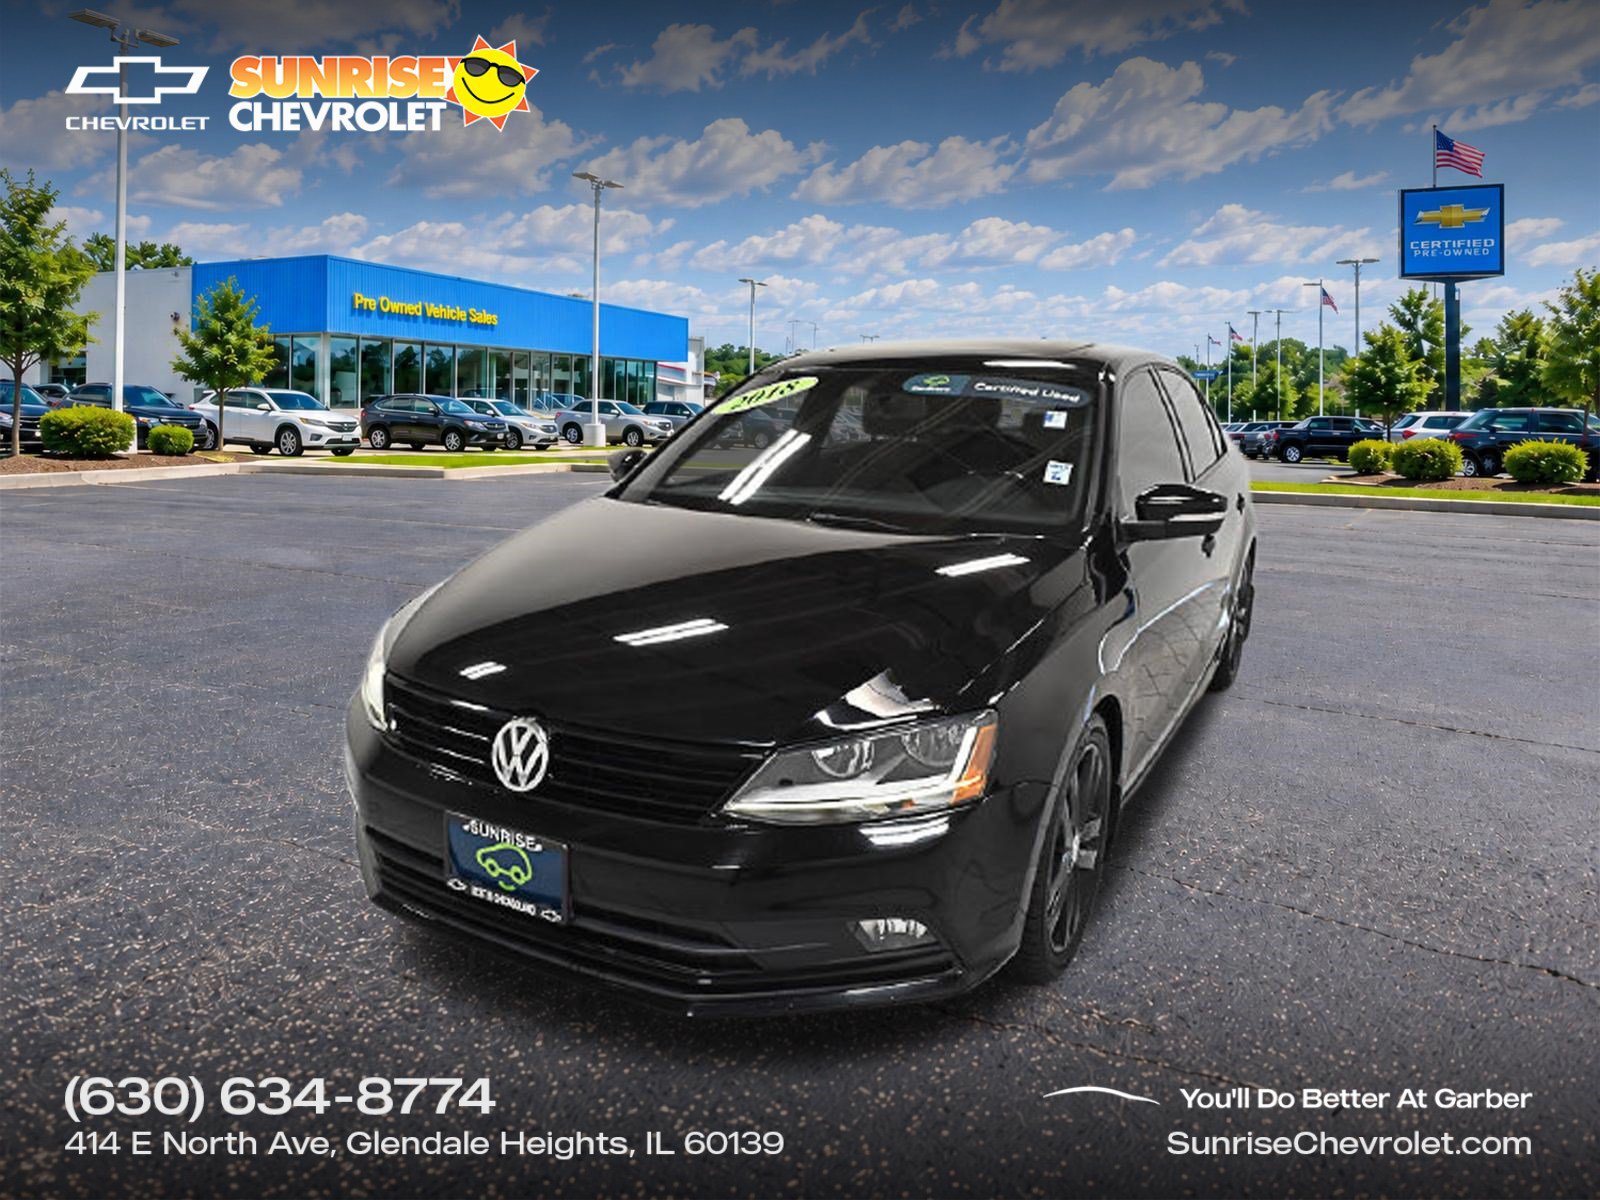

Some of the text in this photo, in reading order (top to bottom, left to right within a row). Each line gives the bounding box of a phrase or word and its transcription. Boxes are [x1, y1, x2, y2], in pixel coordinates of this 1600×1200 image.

[1410, 239, 1495, 249] CERTIFIED
[1414, 248, 1489, 257] PRE-OWNED
[353, 292, 498, 325] Pre Owned Vehicle Sales
[974, 382, 1040, 397] Certified
[469, 819, 536, 851] SUNRISE
